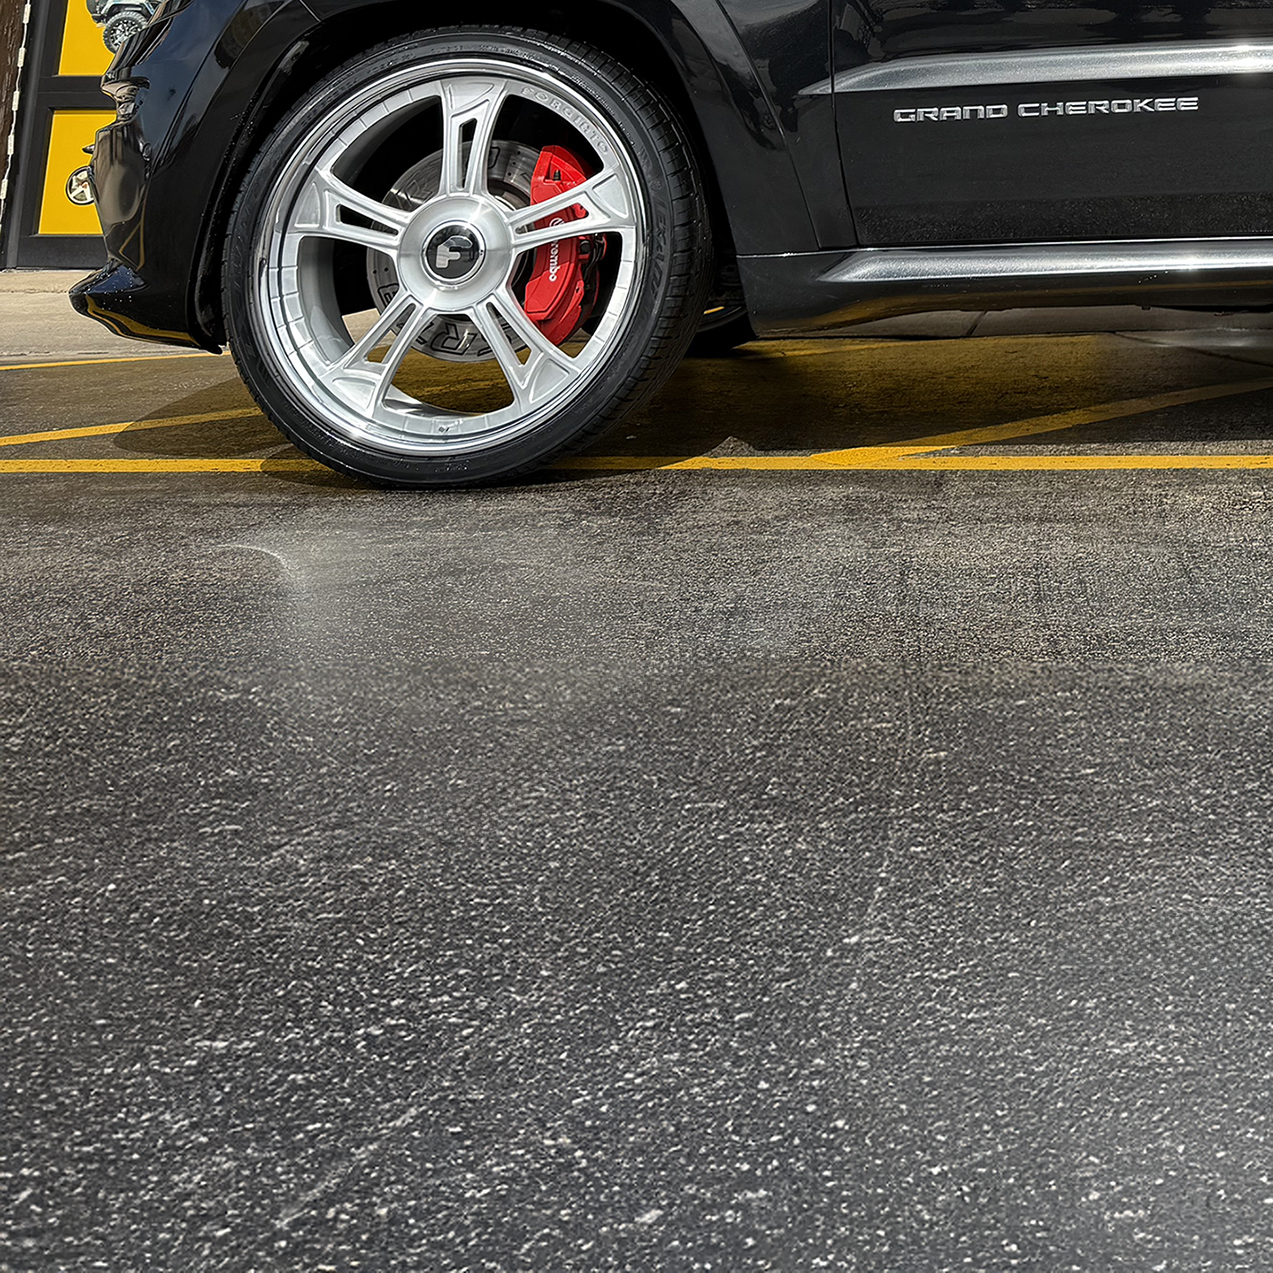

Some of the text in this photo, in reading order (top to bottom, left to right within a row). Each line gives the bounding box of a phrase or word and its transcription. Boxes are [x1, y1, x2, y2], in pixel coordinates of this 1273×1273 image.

[893, 96, 1199, 123] GRAND CHEROKEE
[549, 237, 561, 283] rembo
